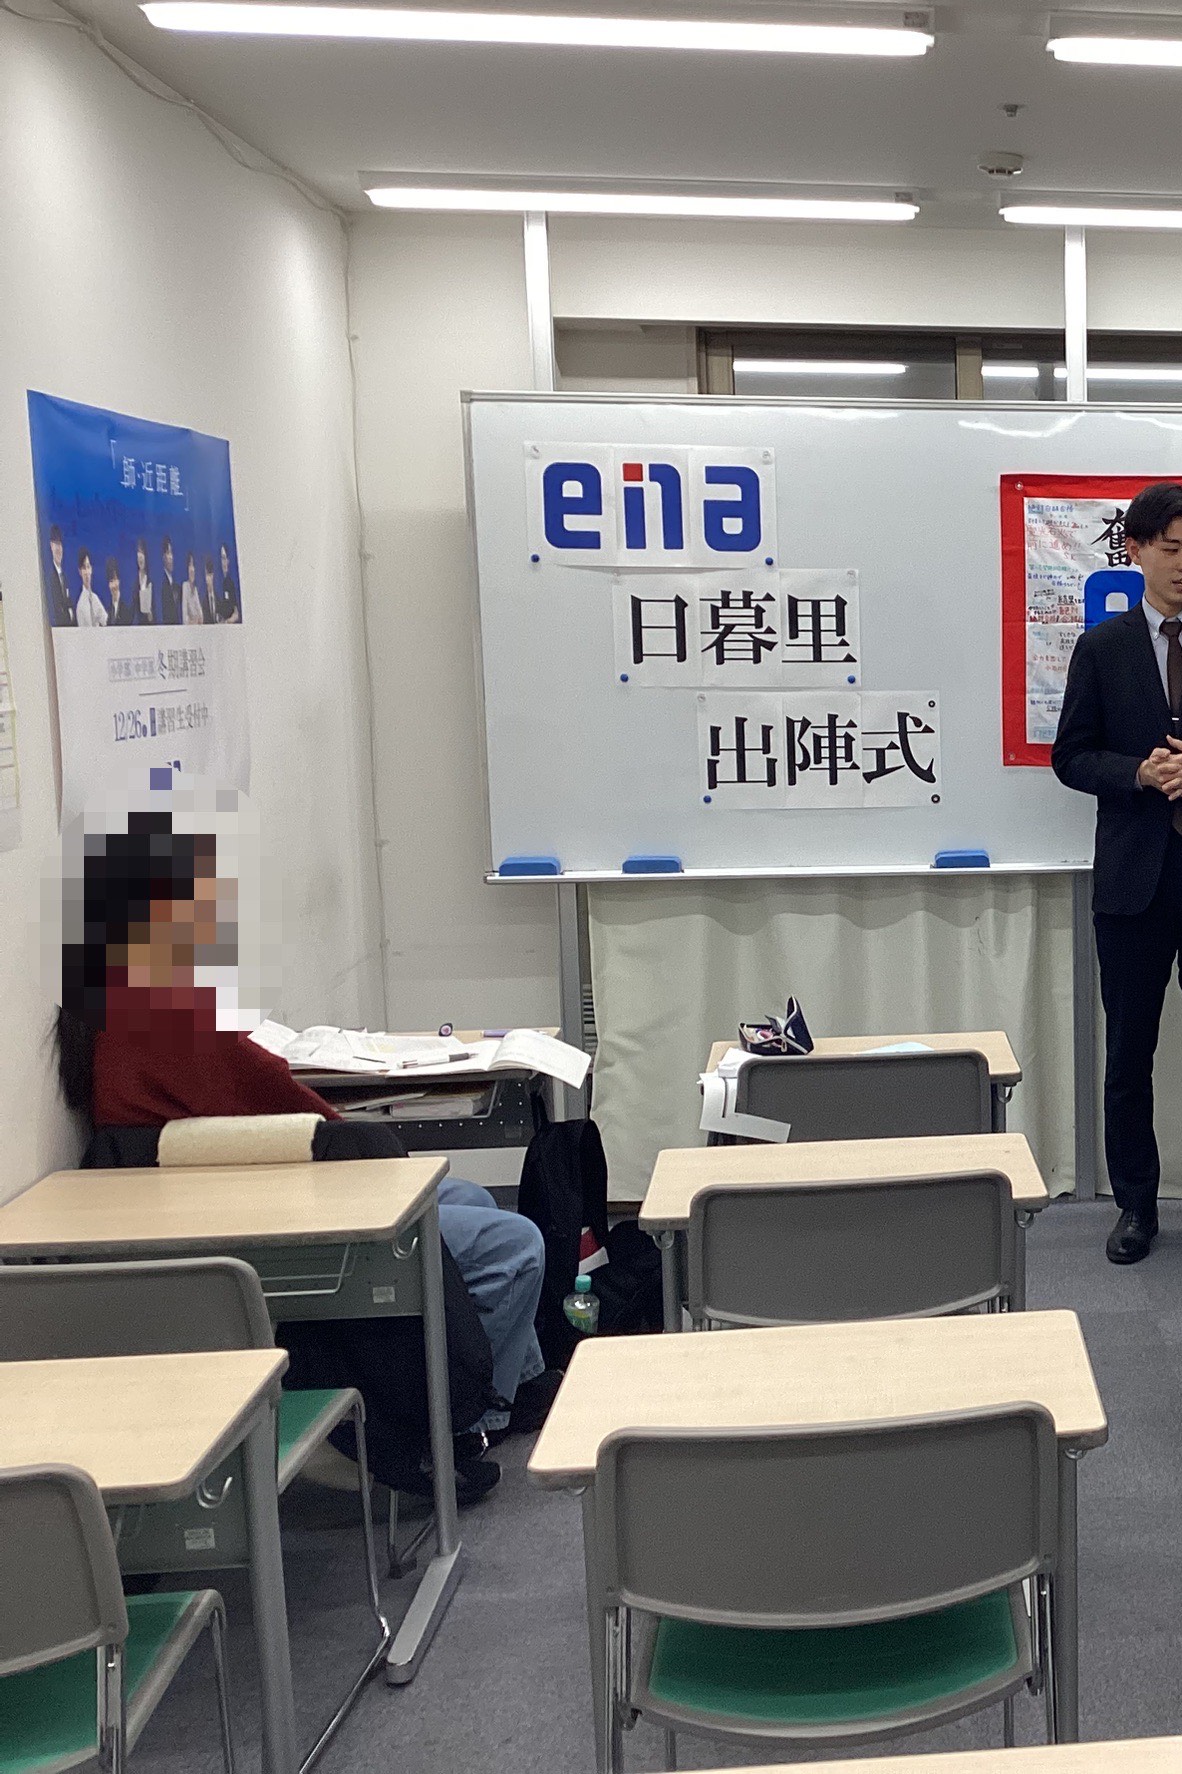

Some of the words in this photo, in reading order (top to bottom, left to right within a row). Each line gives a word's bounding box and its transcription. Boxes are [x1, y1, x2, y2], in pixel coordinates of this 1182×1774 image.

[630, 590, 857, 666] 日暮里
[707, 711, 937, 790] 出陣式
